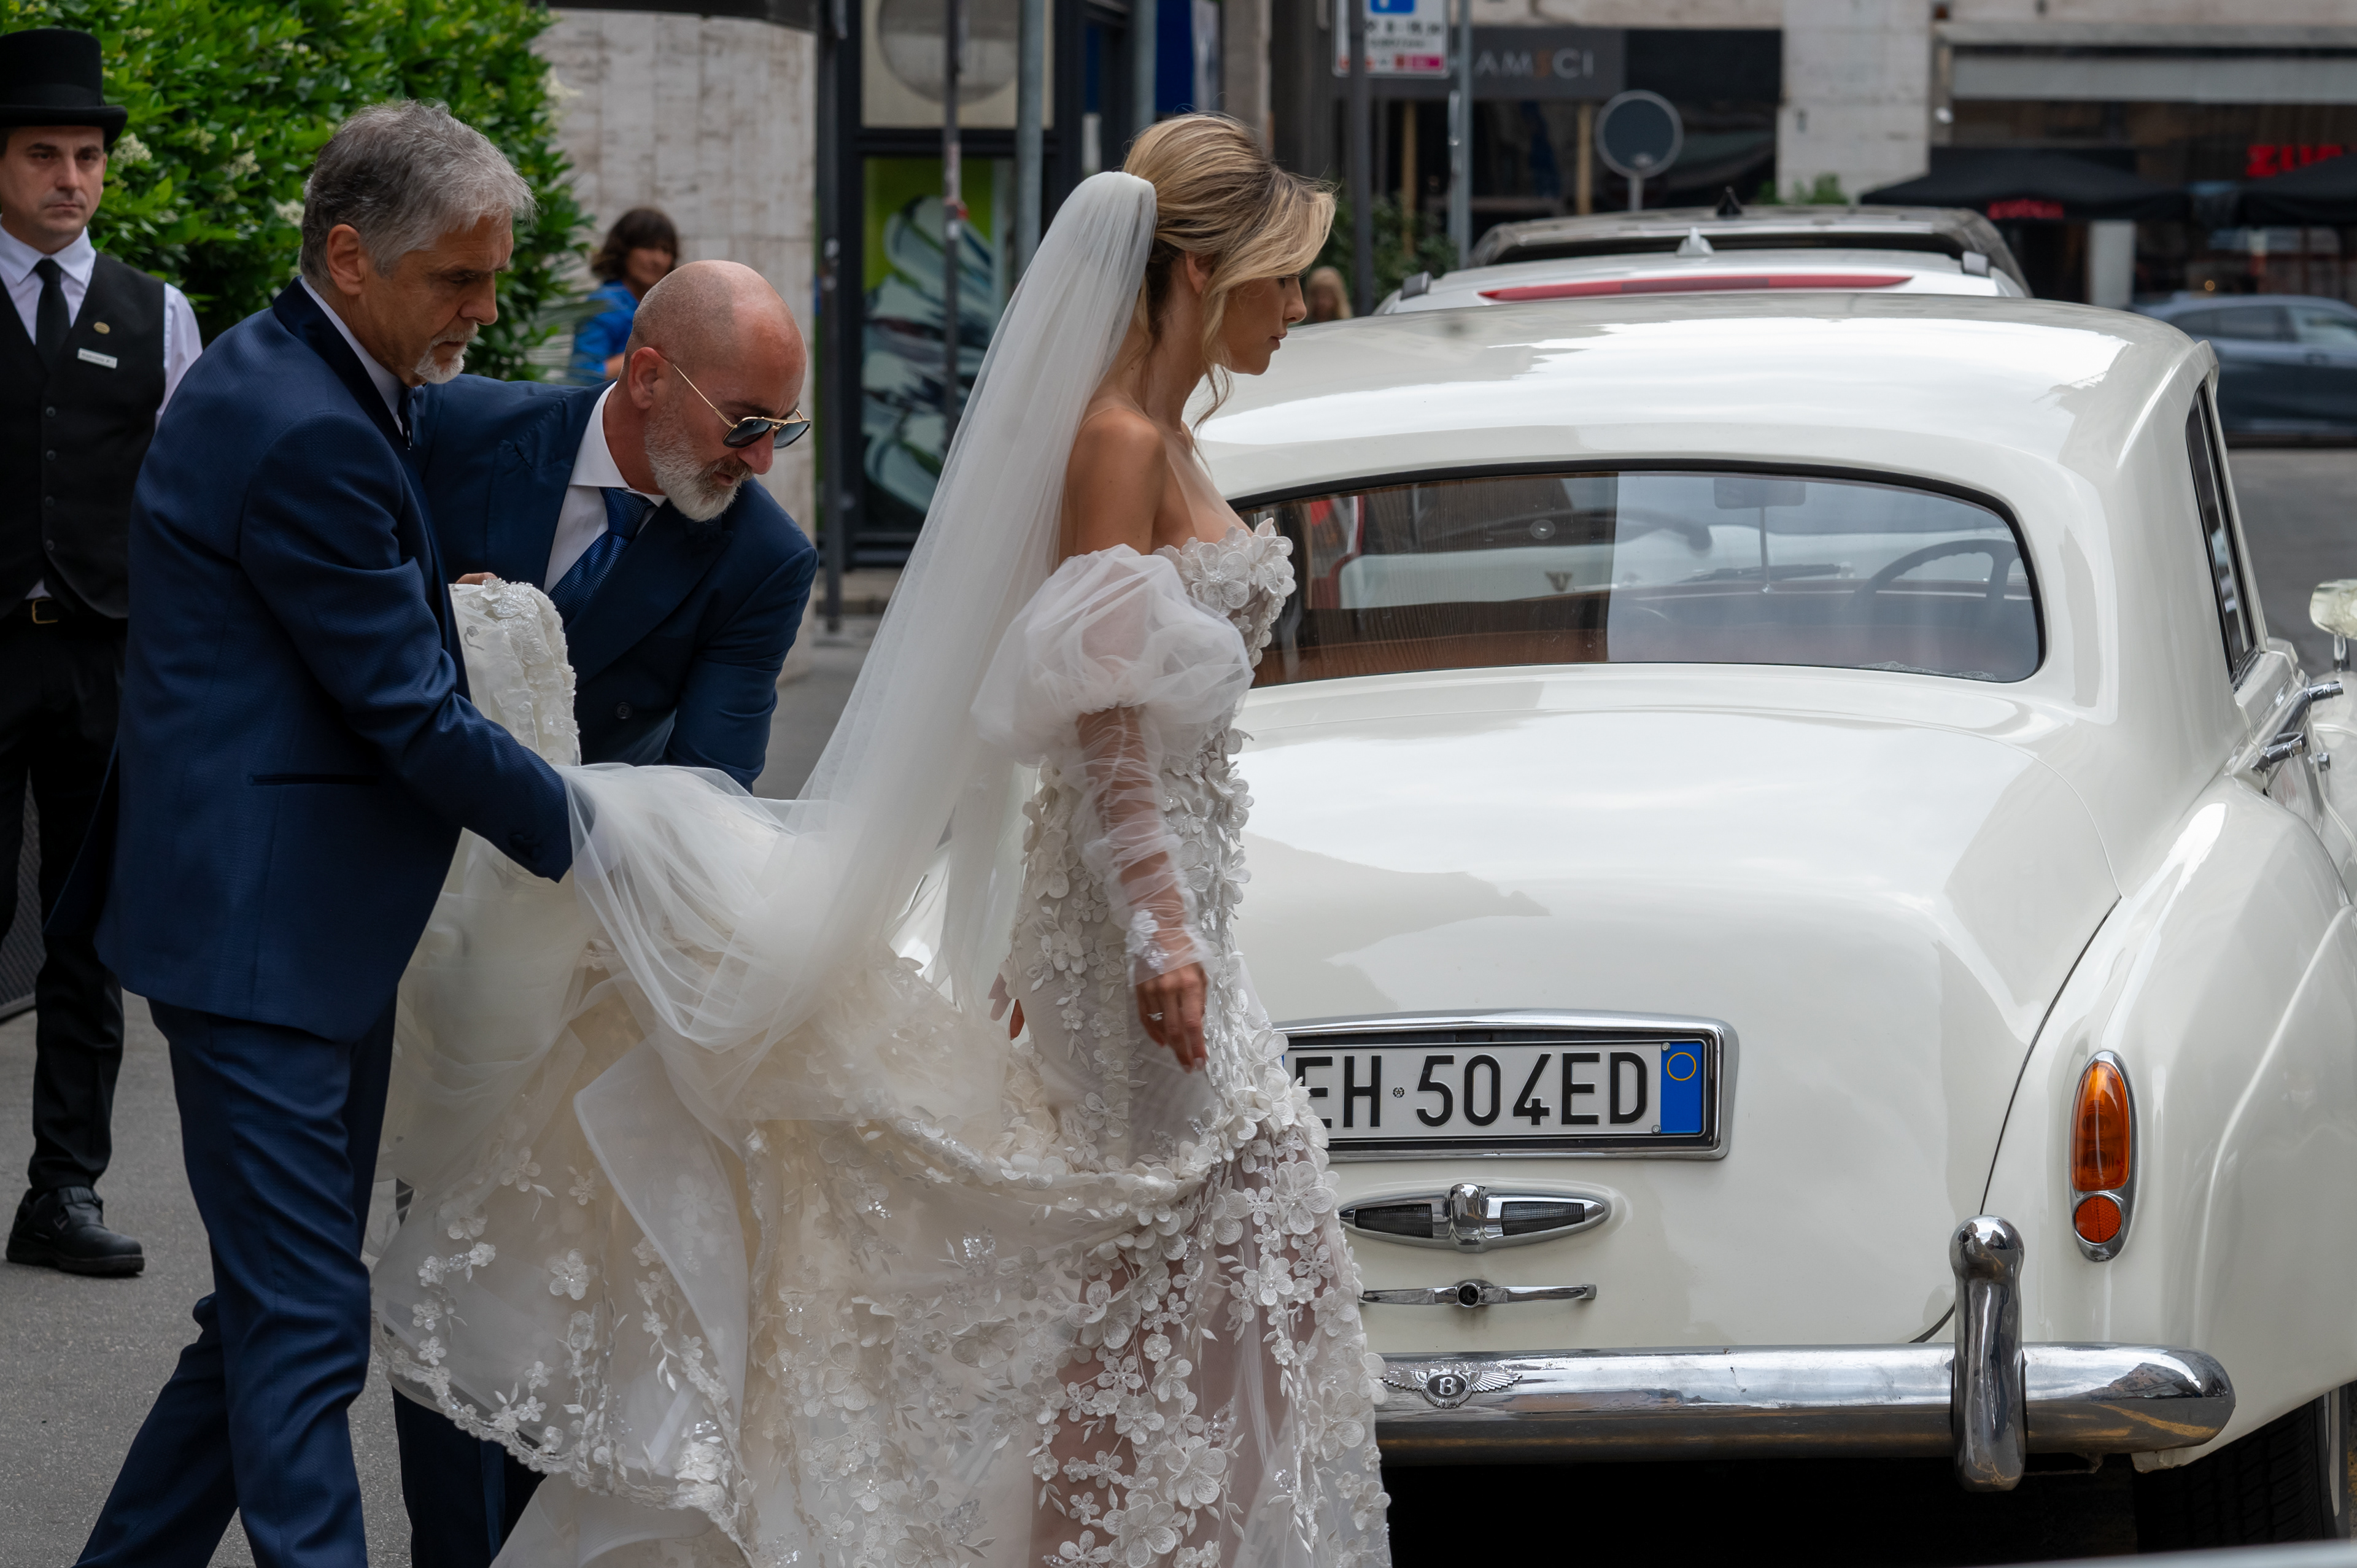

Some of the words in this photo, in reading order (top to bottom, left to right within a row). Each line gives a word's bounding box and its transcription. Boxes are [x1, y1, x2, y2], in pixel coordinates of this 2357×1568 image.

[1295, 1055, 1382, 1128] EH
[1415, 1051, 1649, 1127] 504ED
[1438, 1376, 1458, 1396] B
